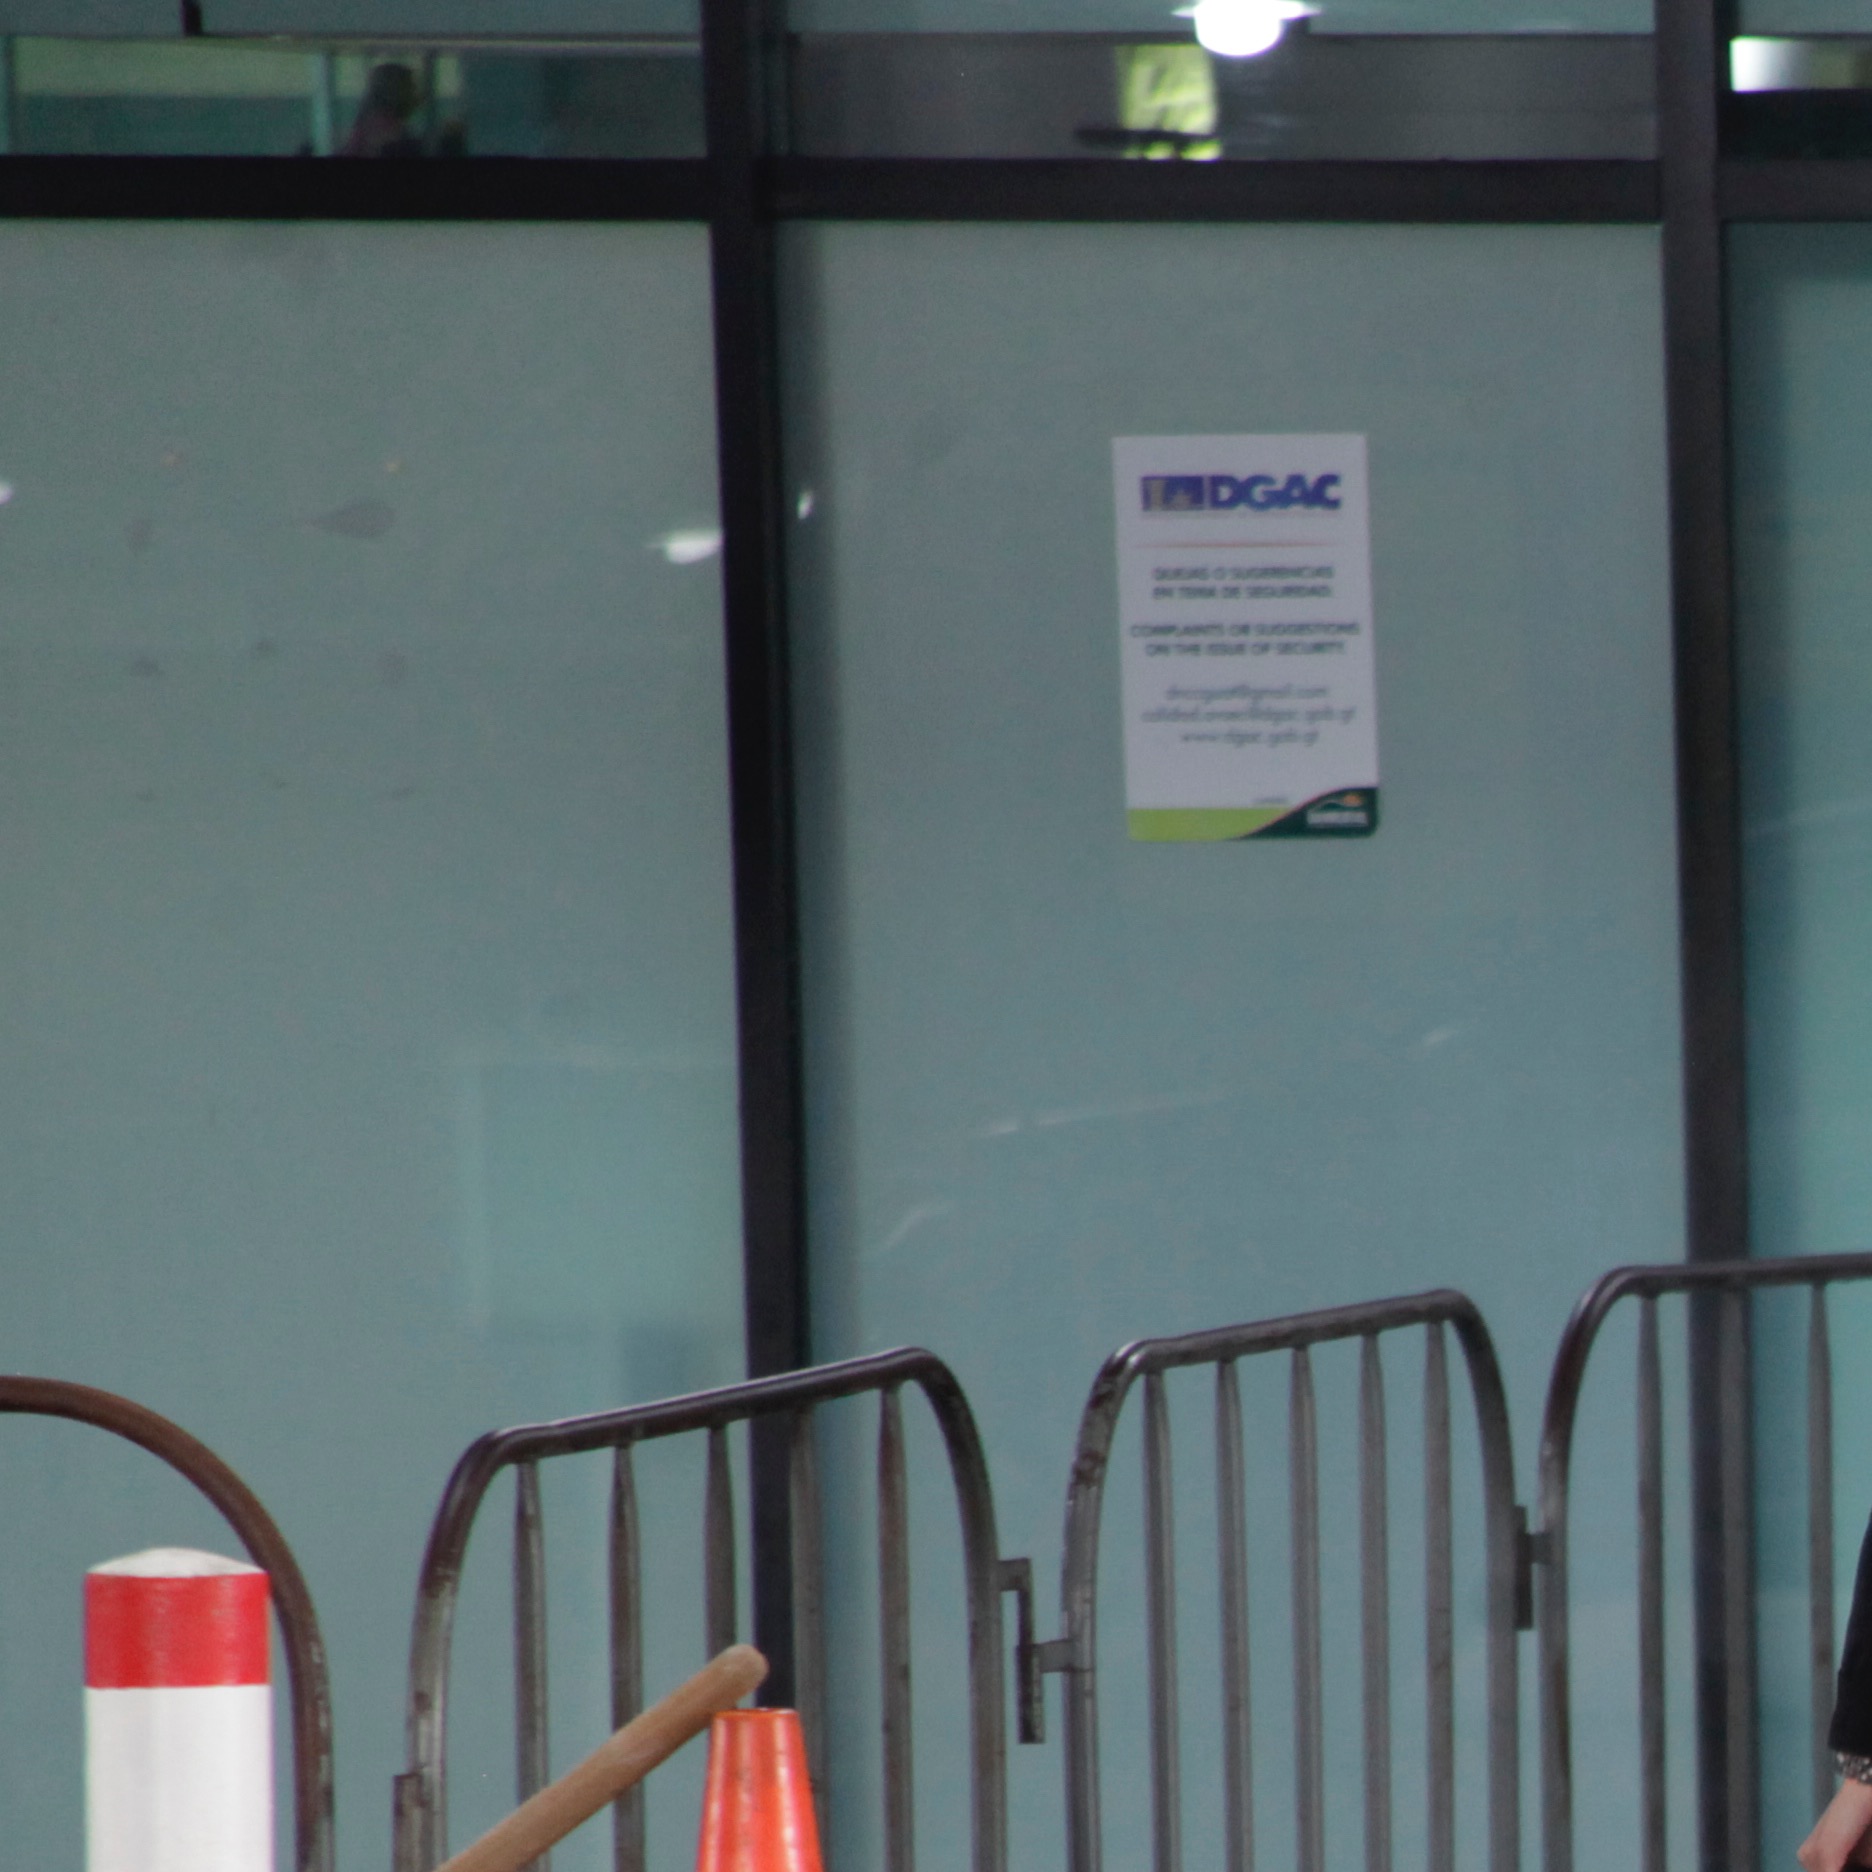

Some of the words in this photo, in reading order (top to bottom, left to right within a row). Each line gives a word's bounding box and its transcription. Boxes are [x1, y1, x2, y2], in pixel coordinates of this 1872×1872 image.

[1209, 474, 1342, 511] DGAC
[1212, 566, 1227, 580] O
[1230, 566, 1334, 580] SUGERENCIAS
[1222, 586, 1241, 599] DE
[1131, 624, 1224, 637] COMPLAINTS
[1228, 624, 1250, 637] OR
[1254, 623, 1359, 636] SUGGESTIONS
[1145, 644, 1170, 657] ON
[1174, 644, 1201, 656] THE
[1206, 643, 1246, 656] ISSUE
[1251, 643, 1270, 655] OF
